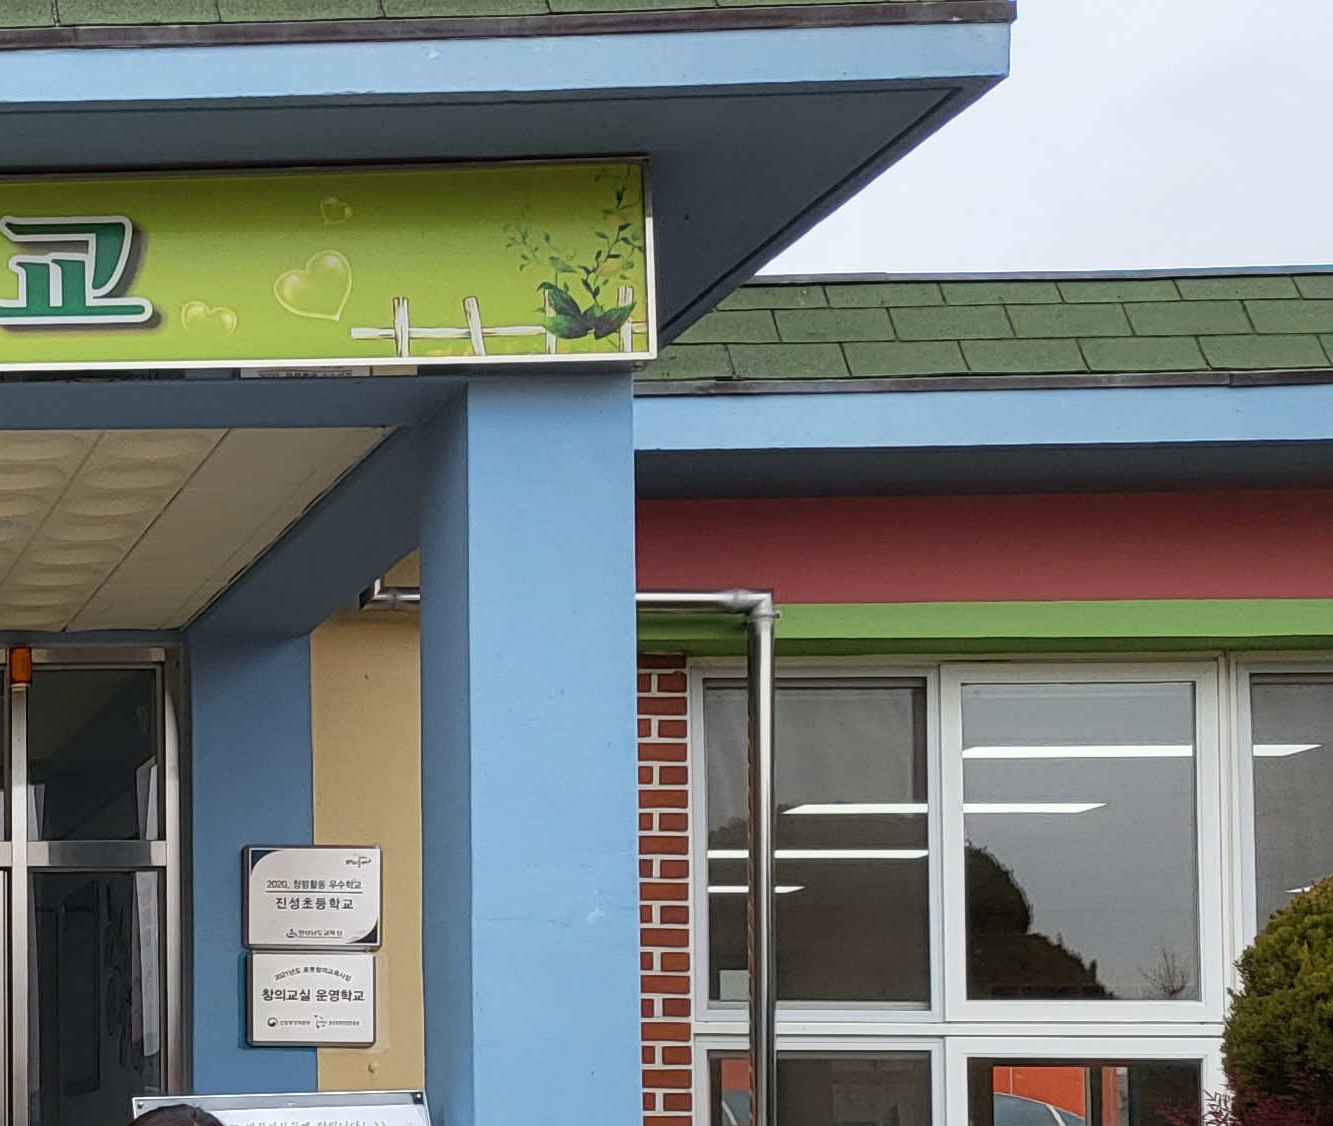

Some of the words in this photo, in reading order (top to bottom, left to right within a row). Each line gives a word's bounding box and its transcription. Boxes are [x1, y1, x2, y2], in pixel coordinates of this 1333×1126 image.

[266, 880, 290, 889] 2020.
[329, 880, 363, 890] 우수학교
[275, 897, 354, 910] 진성초등학교
[262, 988, 311, 1002] 창의교실
[315, 989, 365, 1002] 운영학교
